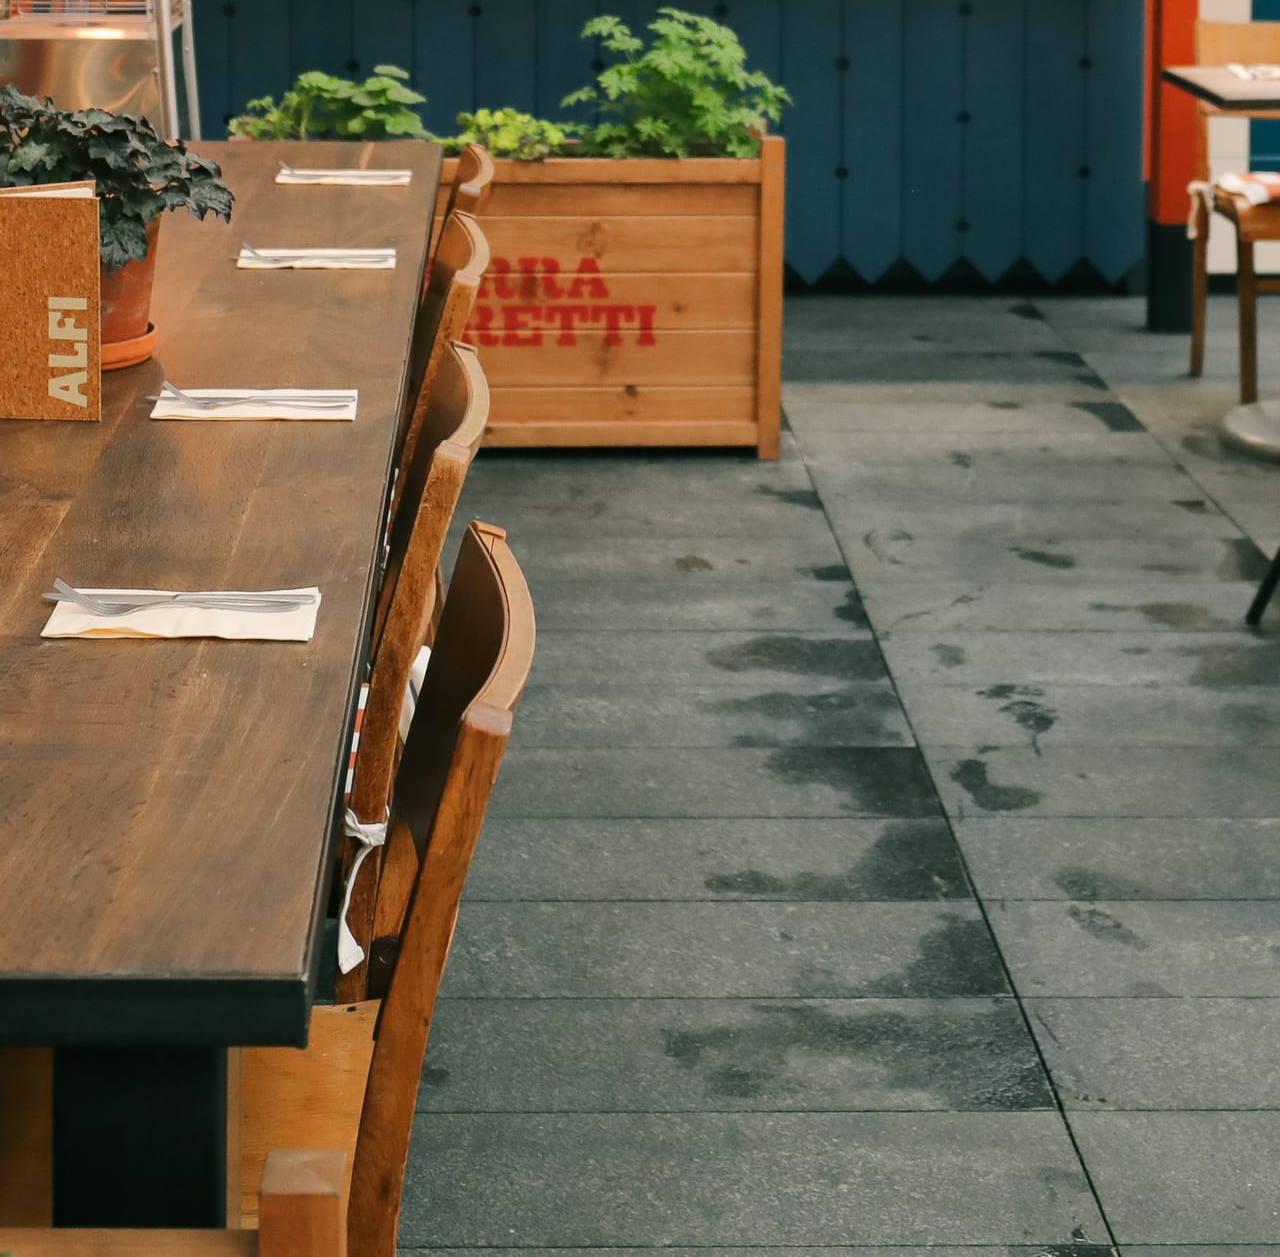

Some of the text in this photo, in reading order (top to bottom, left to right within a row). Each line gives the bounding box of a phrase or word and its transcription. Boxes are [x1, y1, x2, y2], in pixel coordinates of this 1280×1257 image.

[476, 257, 610, 300] RRA
[462, 304, 657, 347] RETTI
[47, 296, 88, 408] ALFI
